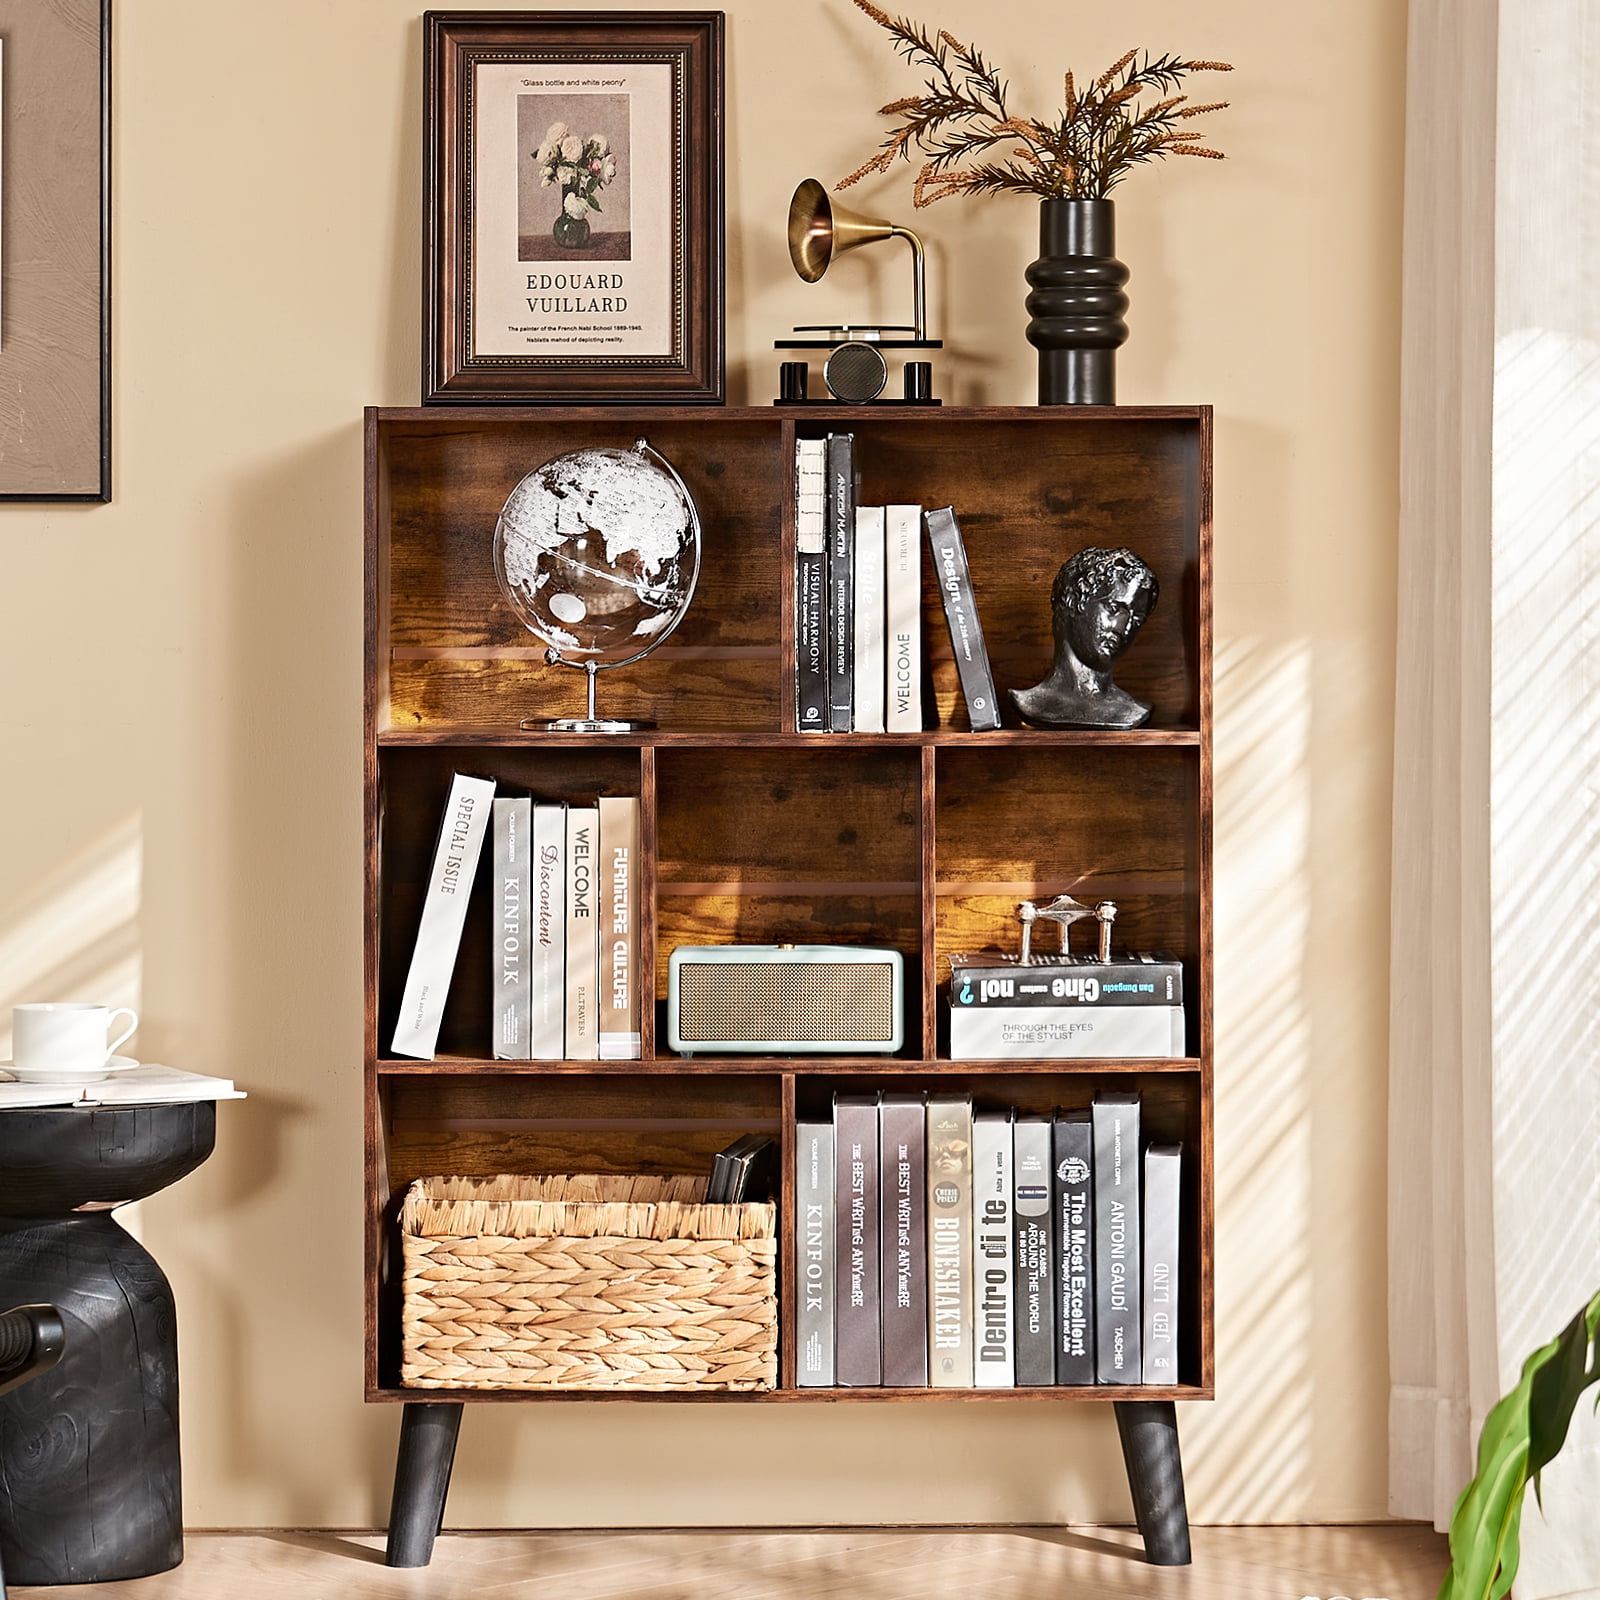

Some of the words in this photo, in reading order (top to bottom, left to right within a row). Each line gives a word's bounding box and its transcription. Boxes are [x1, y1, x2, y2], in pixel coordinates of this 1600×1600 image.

[526, 274, 623, 290] EDOUARD
[526, 297, 628, 313] VUILLARD
[810, 562, 821, 607] VISUAL
[860, 549, 877, 605] Style
[940, 547, 963, 603] Design
[837, 579, 845, 616] INTERIOR
[809, 610, 820, 675] HARMONY
[837, 616, 845, 645] DESIGN
[837, 646, 845, 674] REVIEW
[896, 634, 910, 714] WELCOME
[449, 796, 475, 852] SPECIAL
[440, 855, 463, 895] ISSUE
[574, 827, 590, 918] WELCOME
[539, 845, 559, 948] Discontent
[503, 877, 520, 985] KINFOLK
[613, 940, 629, 1010] CULTURE
[980, 979, 1015, 1003] noi
[1051, 977, 1100, 1003] Cine
[1138, 983, 1154, 993] Dan
[1002, 1023, 1047, 1032] THROUGH
[1050, 1023, 1068, 1032] THE
[1069, 1023, 1094, 1032] EYES
[1002, 1032, 1016, 1041] OF
[1018, 1032, 1035, 1040] THE
[1037, 1031, 1074, 1040] STYLIST
[851, 1143, 862, 1160] THE
[898, 1144, 909, 1161] THE
[851, 1162, 864, 1194] BEST
[898, 1162, 911, 1195] BEST
[981, 1200, 1007, 1226] te
[1071, 1192, 1086, 1226] The
[1019, 1230, 1027, 1238] IN
[1028, 1222, 1039, 1269] AROUND
[1039, 1230, 1047, 1246] ONE
[1110, 1200, 1125, 1259] ANTONI
[806, 1203, 823, 1312] KINFOLK
[1039, 1248, 1047, 1278] CLASSIC
[1062, 1251, 1070, 1283] Tragedy
[1071, 1229, 1086, 1272] Most
[934, 1216, 961, 1349] BONESHAKER
[1029, 1270, 1039, 1292] THE
[1063, 1283, 1070, 1291] of
[1110, 1262, 1128, 1312] GAUDÍ
[1153, 1264, 1170, 1304] LIND
[980, 1269, 1007, 1364] Dentro
[1029, 1294, 1039, 1333] WORLD
[1071, 1276, 1086, 1356] Excellent
[1152, 1313, 1171, 1344] JED
[1114, 1326, 1124, 1369] TASCHEN
